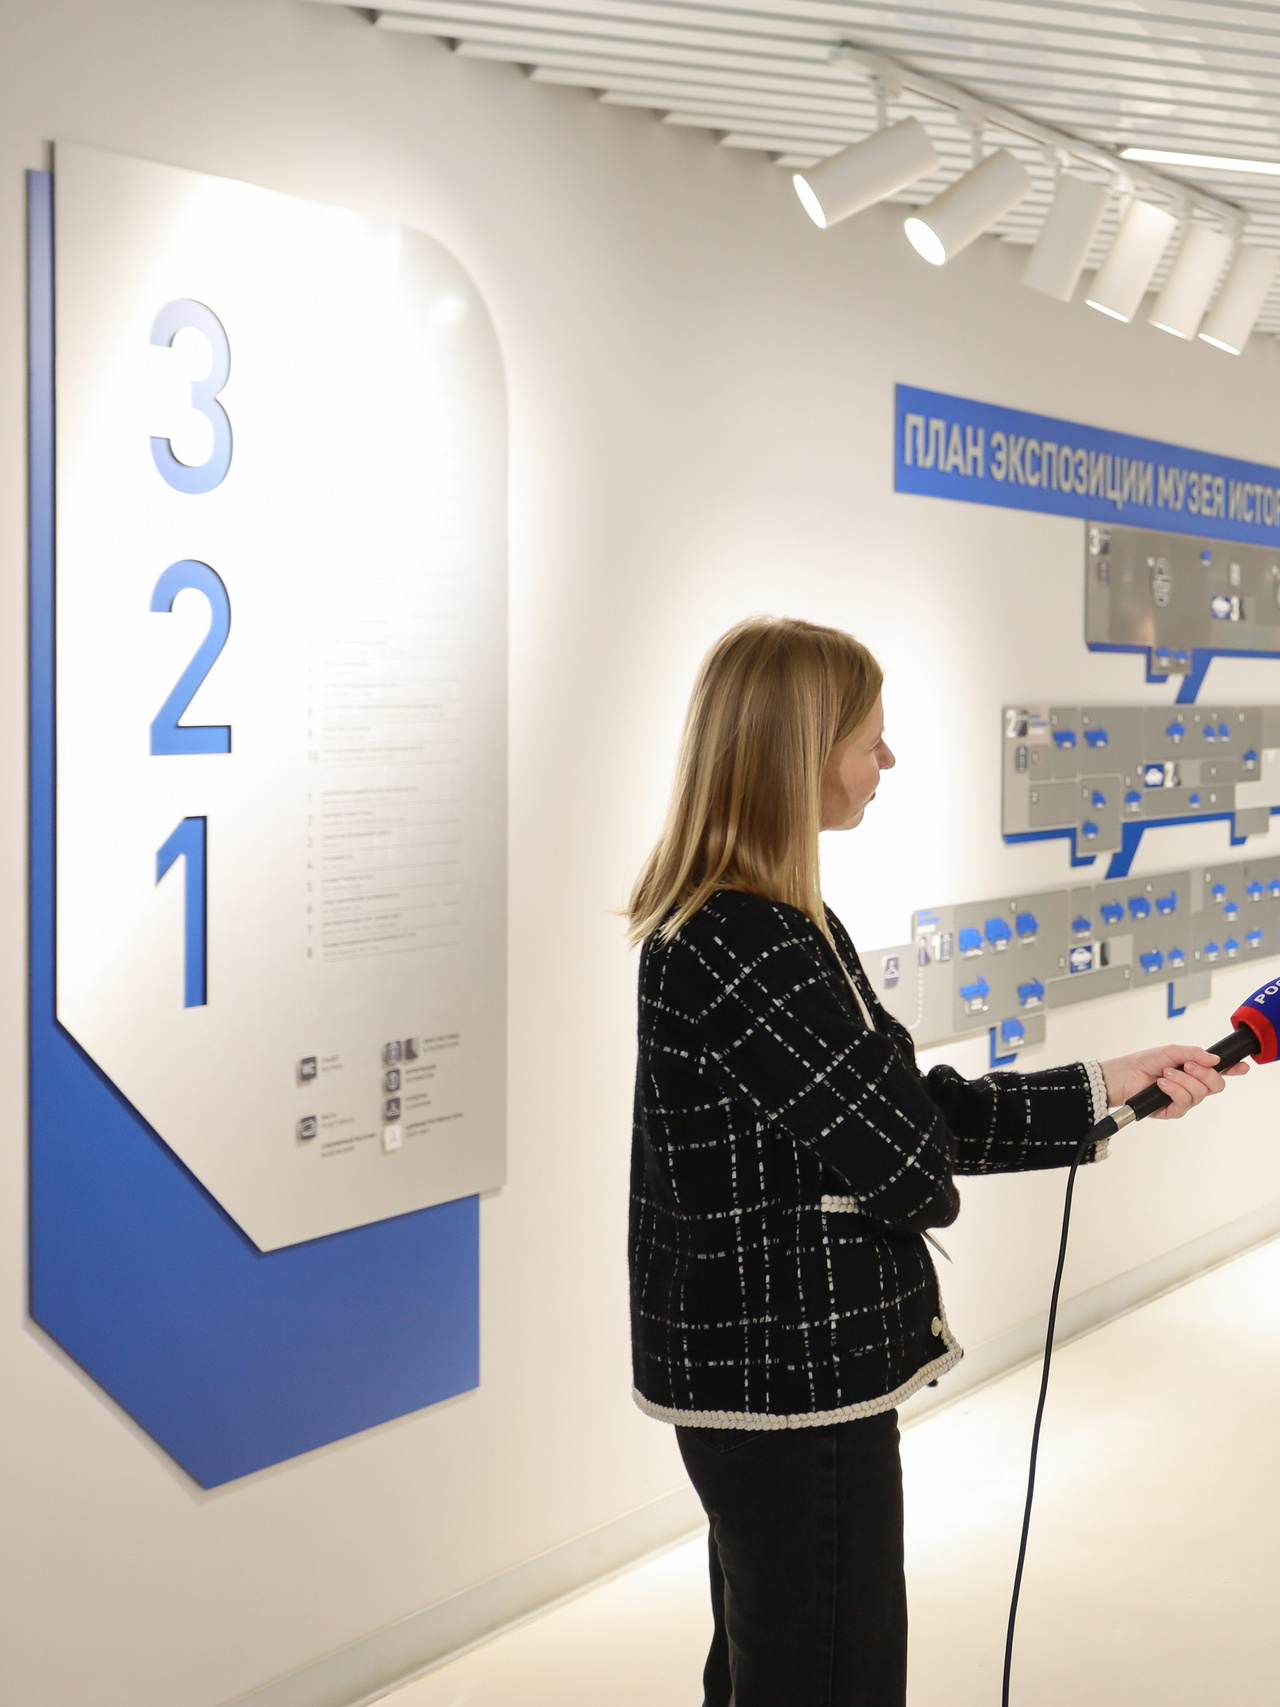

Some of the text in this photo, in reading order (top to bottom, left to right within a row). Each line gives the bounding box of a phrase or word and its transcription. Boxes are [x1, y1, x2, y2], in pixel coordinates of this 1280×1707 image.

[149, 297, 233, 494] 3
[904, 412, 985, 478] ПЛАН
[989, 430, 1153, 511] ЭКСПОЗИЦИИ
[1157, 464, 1225, 520] МУЗЕЯ
[149, 559, 231, 756] 2
[155, 815, 207, 1009] 1
